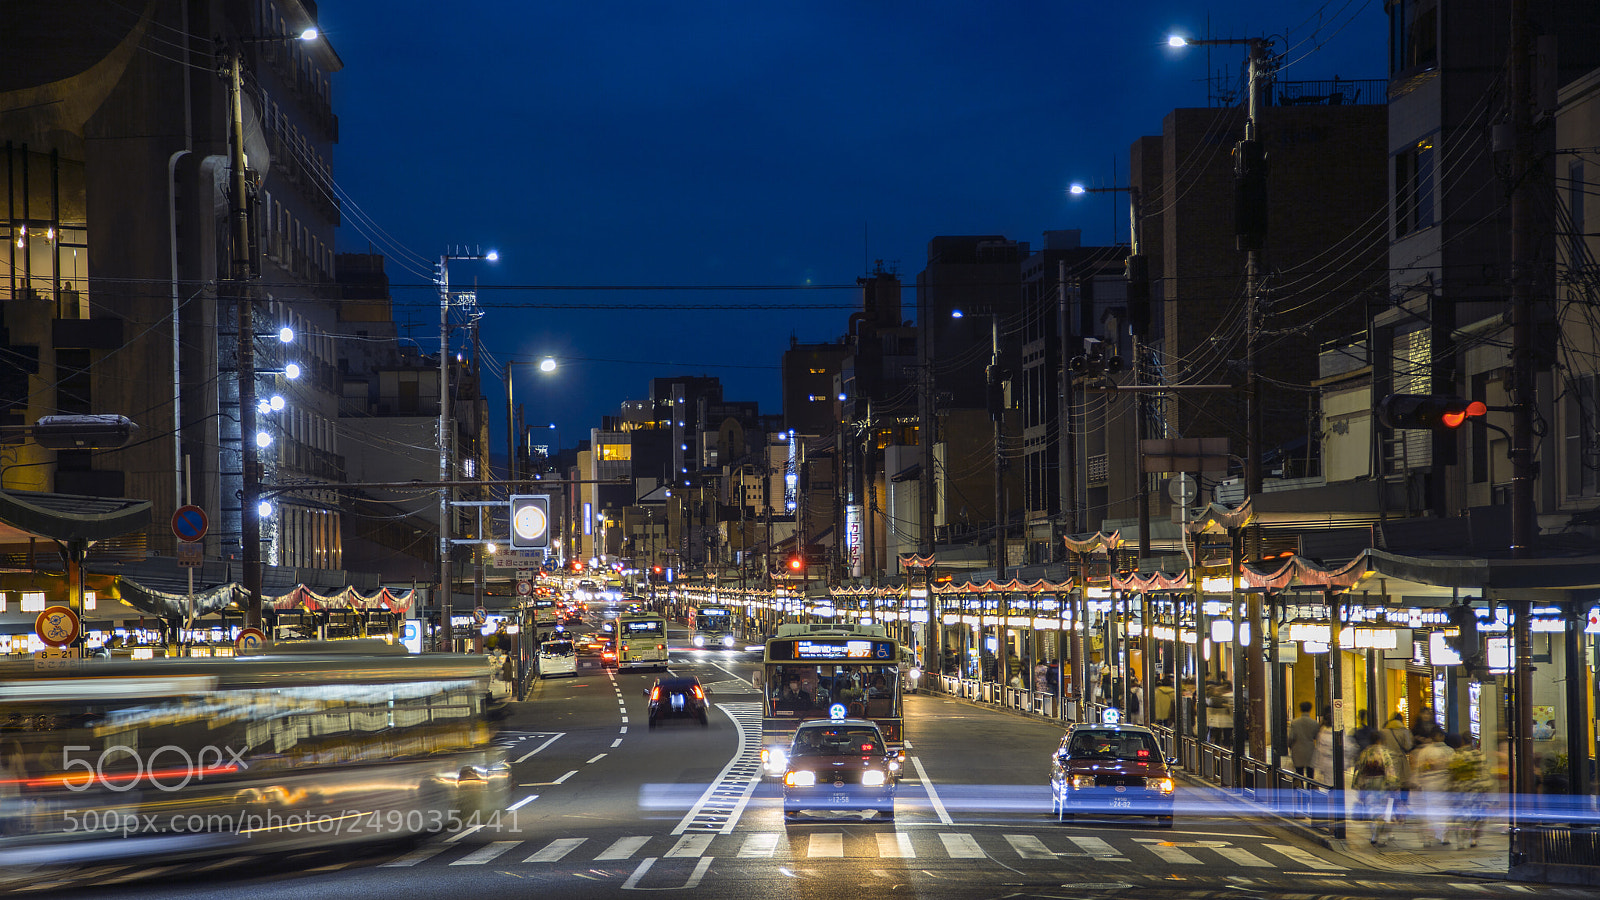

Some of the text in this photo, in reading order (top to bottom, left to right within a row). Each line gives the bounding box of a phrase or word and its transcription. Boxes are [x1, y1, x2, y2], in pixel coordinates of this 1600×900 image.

[851, 524, 860, 565] カラオケ
[850, 649, 870, 657] 207
